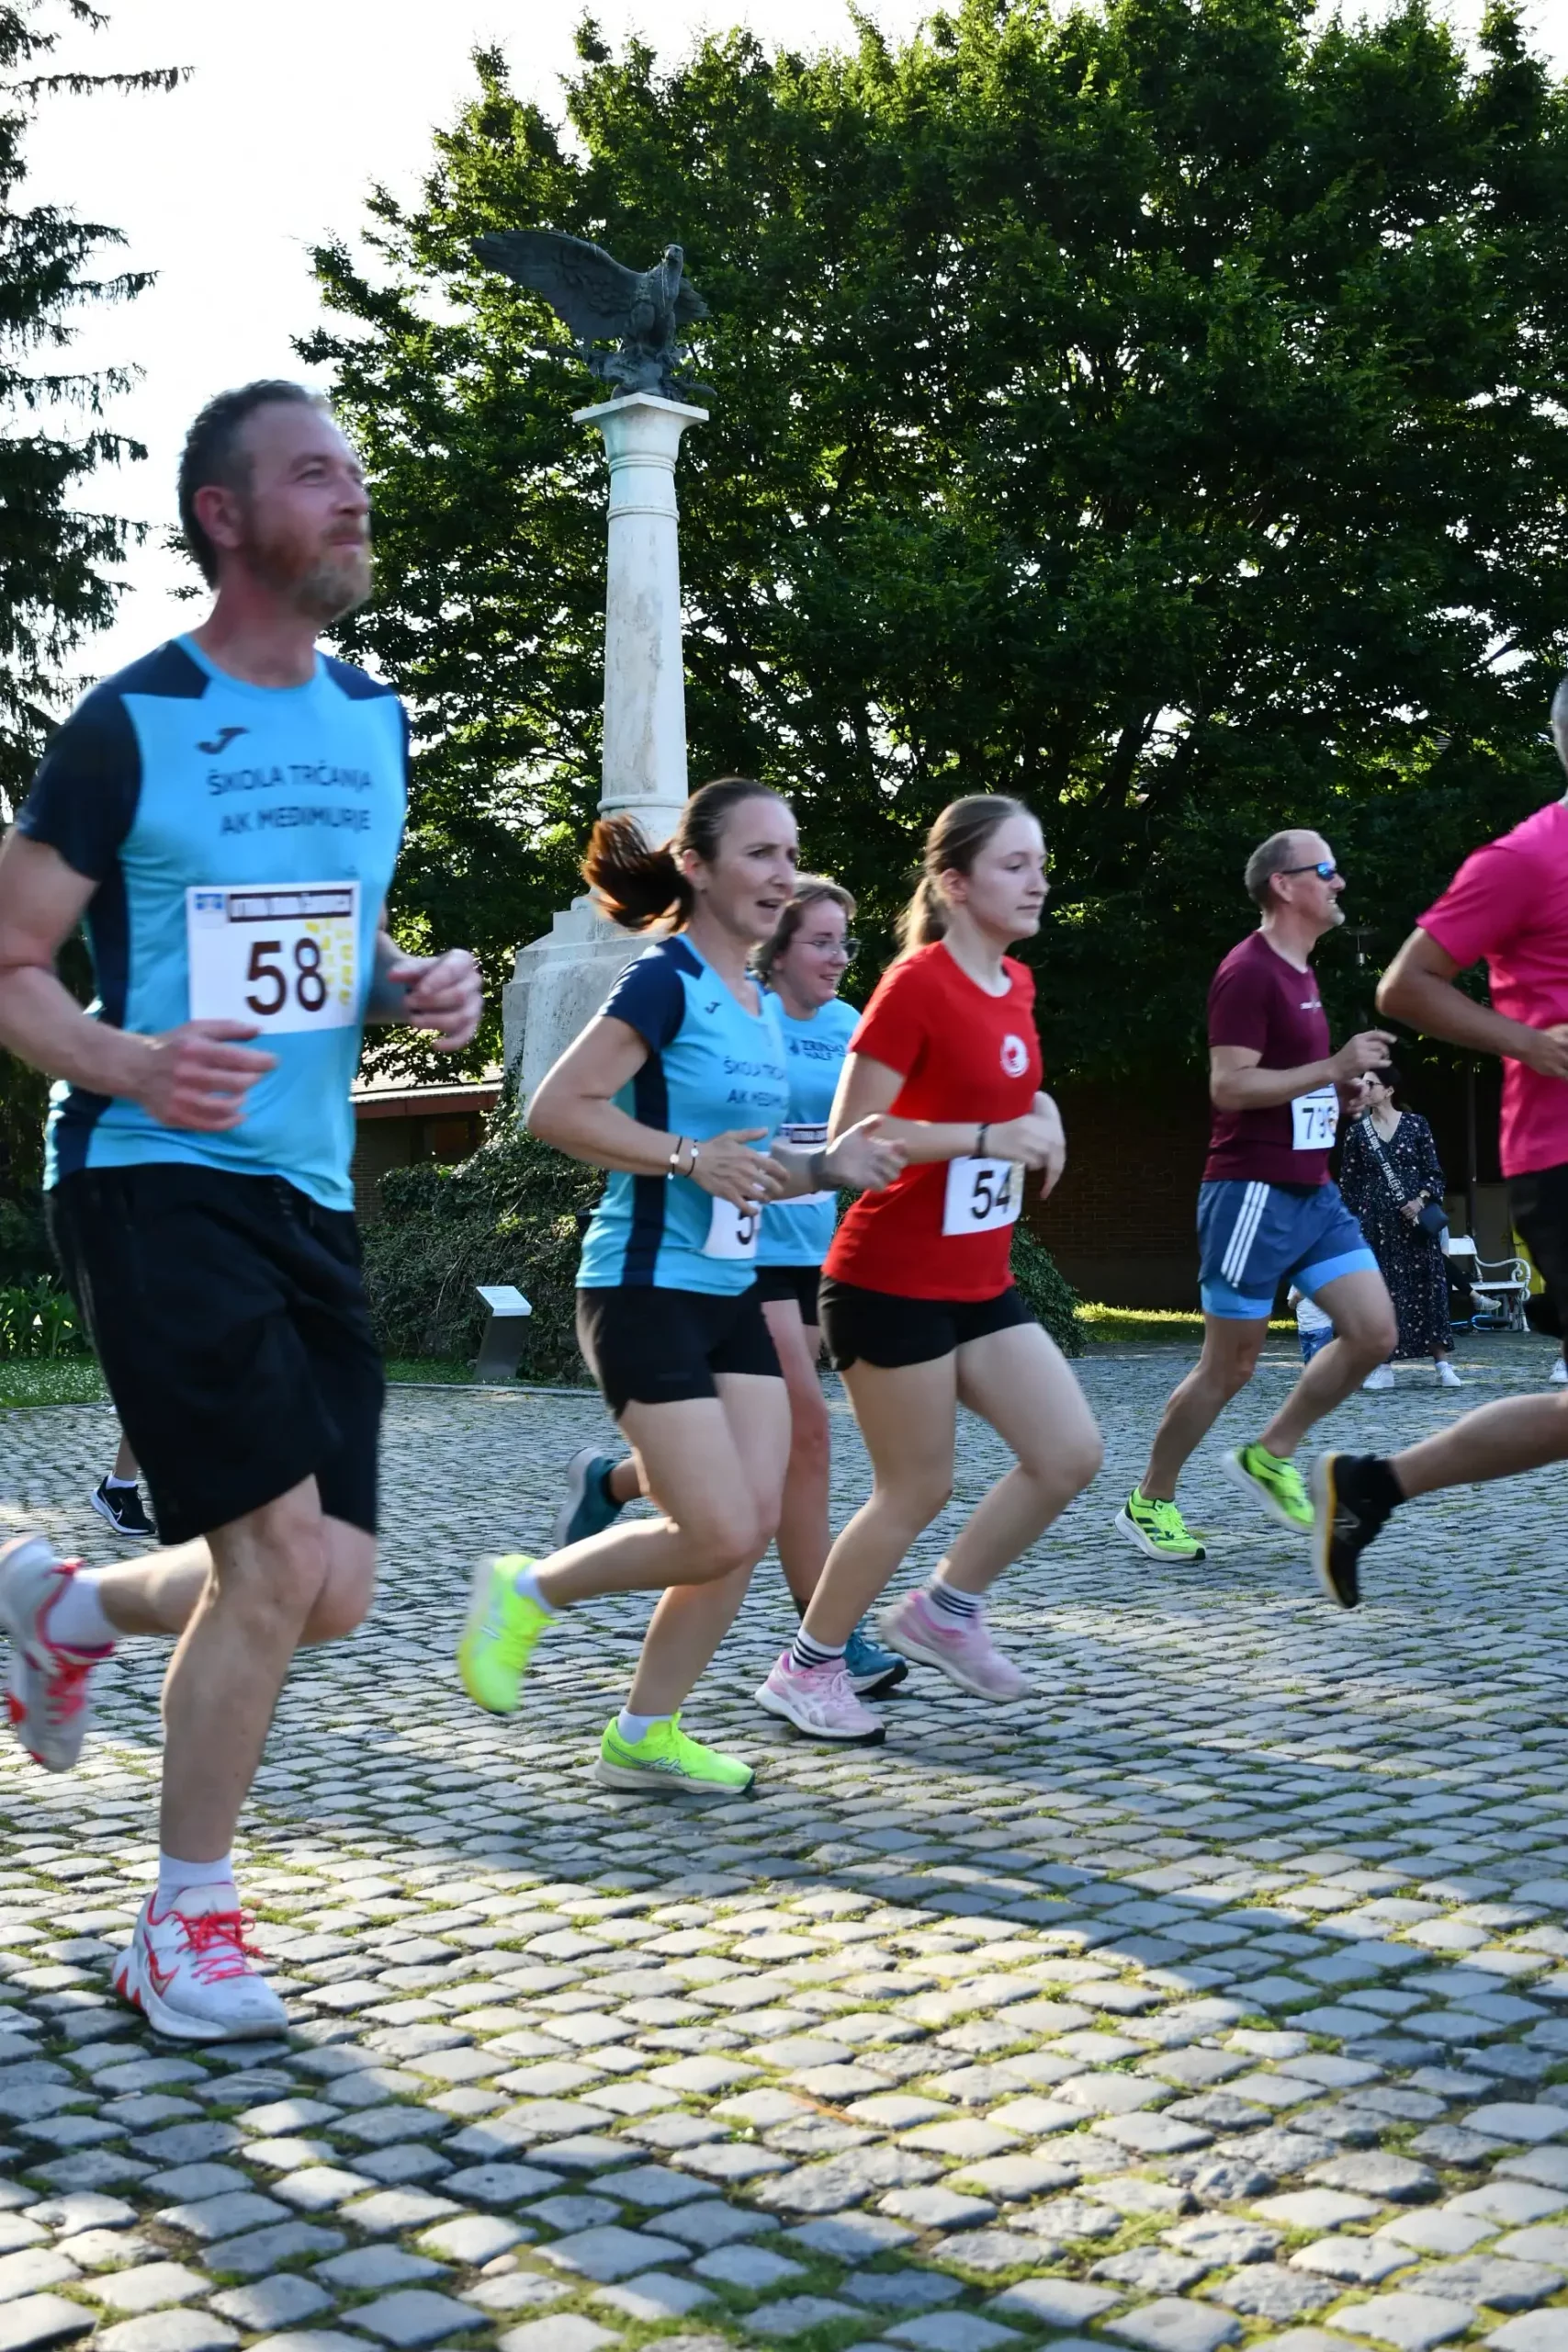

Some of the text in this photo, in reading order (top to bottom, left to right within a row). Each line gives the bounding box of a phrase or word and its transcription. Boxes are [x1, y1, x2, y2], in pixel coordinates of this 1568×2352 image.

[208, 760, 372, 796] ŠKOLA TRČANJA
[220, 812, 252, 836] AK
[245, 937, 327, 1016] 58
[971, 1165, 1012, 1219] 54
